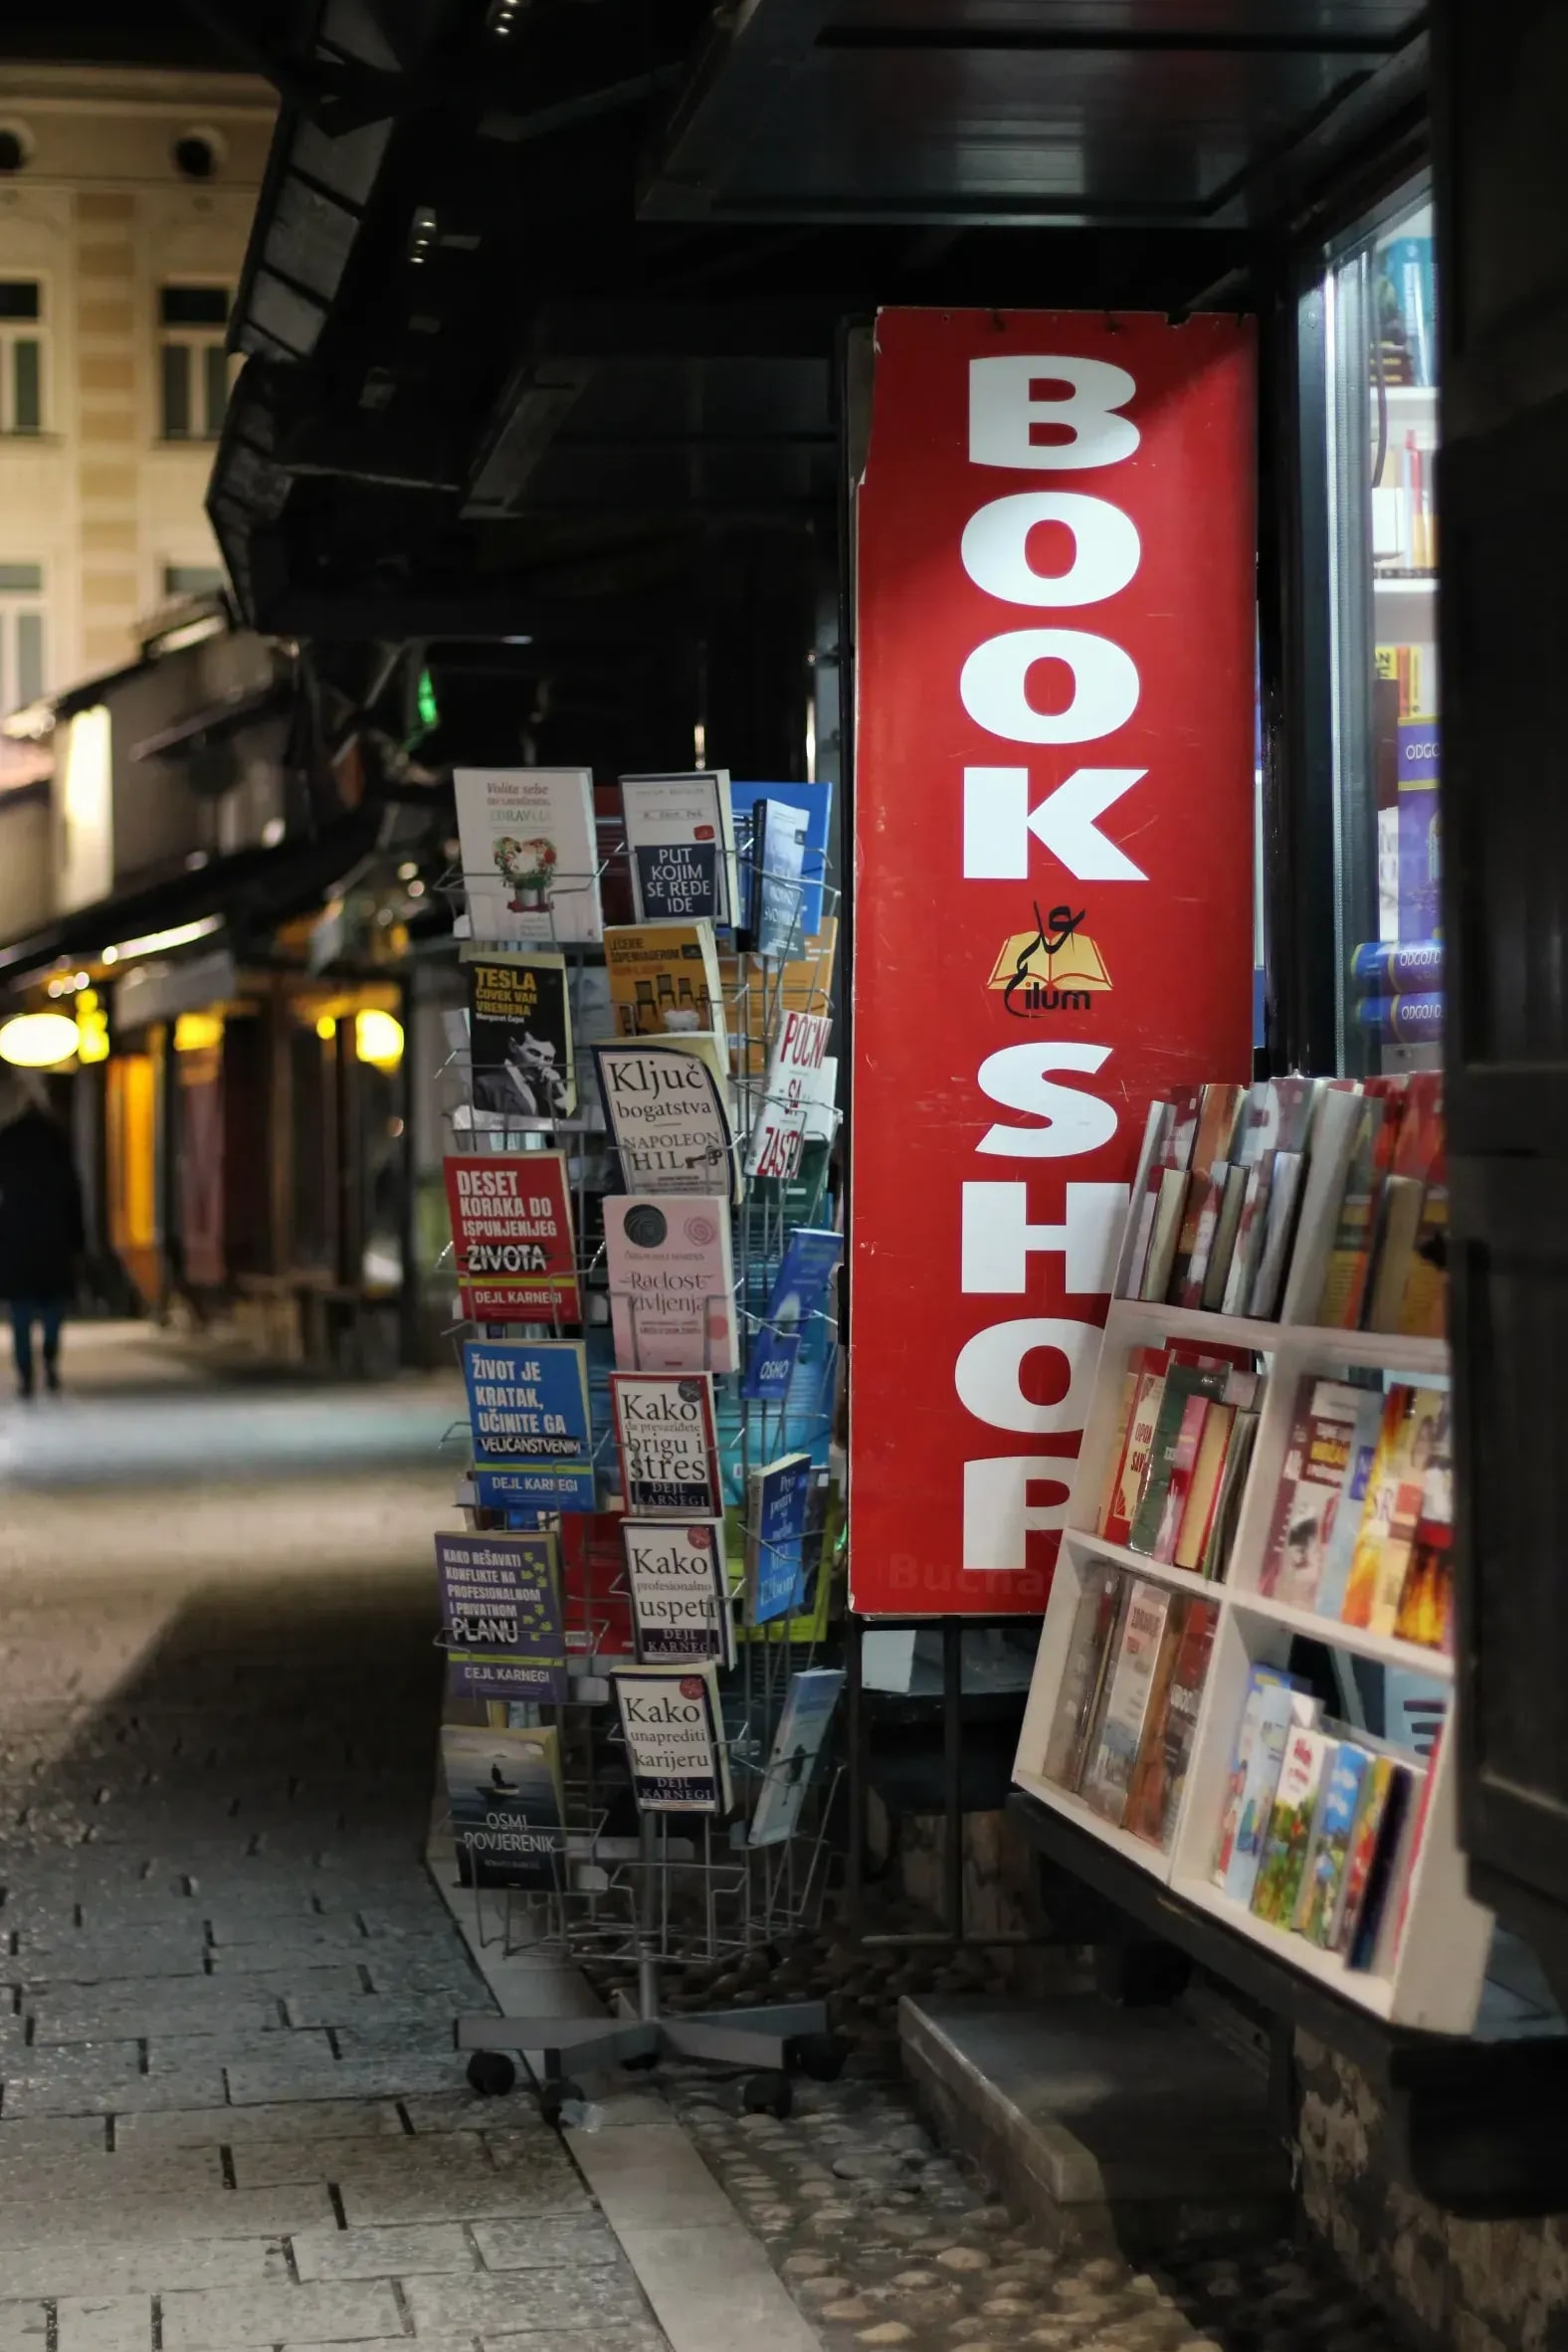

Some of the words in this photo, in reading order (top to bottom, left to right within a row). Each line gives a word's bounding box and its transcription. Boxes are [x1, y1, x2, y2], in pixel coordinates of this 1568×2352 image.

[960, 354, 1150, 882] BOOK
[659, 848, 692, 864] PUT
[651, 864, 702, 882] KOJIM
[647, 882, 666, 897] SE
[667, 897, 694, 913] IDE
[475, 966, 537, 992] TESLA
[514, 990, 538, 1004] VAN
[607, 1060, 704, 1100] Ključ
[616, 1100, 712, 1122] bogatstva
[622, 1131, 720, 1150] NAPOLEON
[456, 1170, 518, 1197] DESET
[460, 1196, 524, 1218] KORAKA
[529, 1197, 552, 1218] DO
[463, 1220, 557, 1237] ISPUNJENIJEG
[466, 1238, 547, 1272] ŽIVOTA
[621, 1271, 713, 1290] Radost
[475, 1290, 506, 1304] DEJL
[955, 1041, 1132, 1570] SHOP
[471, 1352, 515, 1380] ŽIVOT
[520, 1361, 542, 1382] JE
[759, 1359, 790, 1380] OSHO
[476, 1385, 544, 1410] KRATAK,
[621, 1393, 697, 1421] Kako
[479, 1408, 540, 1434] UČINITE
[543, 1414, 567, 1435] GA
[625, 1421, 638, 1431] da
[626, 1431, 688, 1460] brigu
[696, 1433, 705, 1454] i
[630, 1455, 705, 1481] stres
[491, 1476, 523, 1490] DEJL
[653, 1481, 686, 1494] DEJL
[443, 1548, 470, 1565] KAKO
[473, 1549, 521, 1567] REŠAVATI
[631, 1547, 708, 1575] Kako
[445, 1566, 499, 1584] KONFLIKTE
[501, 1571, 516, 1585] NA
[447, 1584, 542, 1602] PROFESIONALNOM
[637, 1580, 712, 1594] profesionalno
[456, 1602, 518, 1618] PRIVATNOM
[451, 1617, 518, 1644] PLANU
[664, 1629, 698, 1642] DEJL
[623, 1696, 700, 1723] Kako
[630, 1728, 706, 1747] unaprediti
[633, 1748, 709, 1773] karijeru
[657, 1777, 692, 1790] DEJL
[642, 1788, 711, 1800] KARNEGI
[486, 1812, 528, 1832] OSMI
[464, 1832, 556, 1853] POVJERENIK
